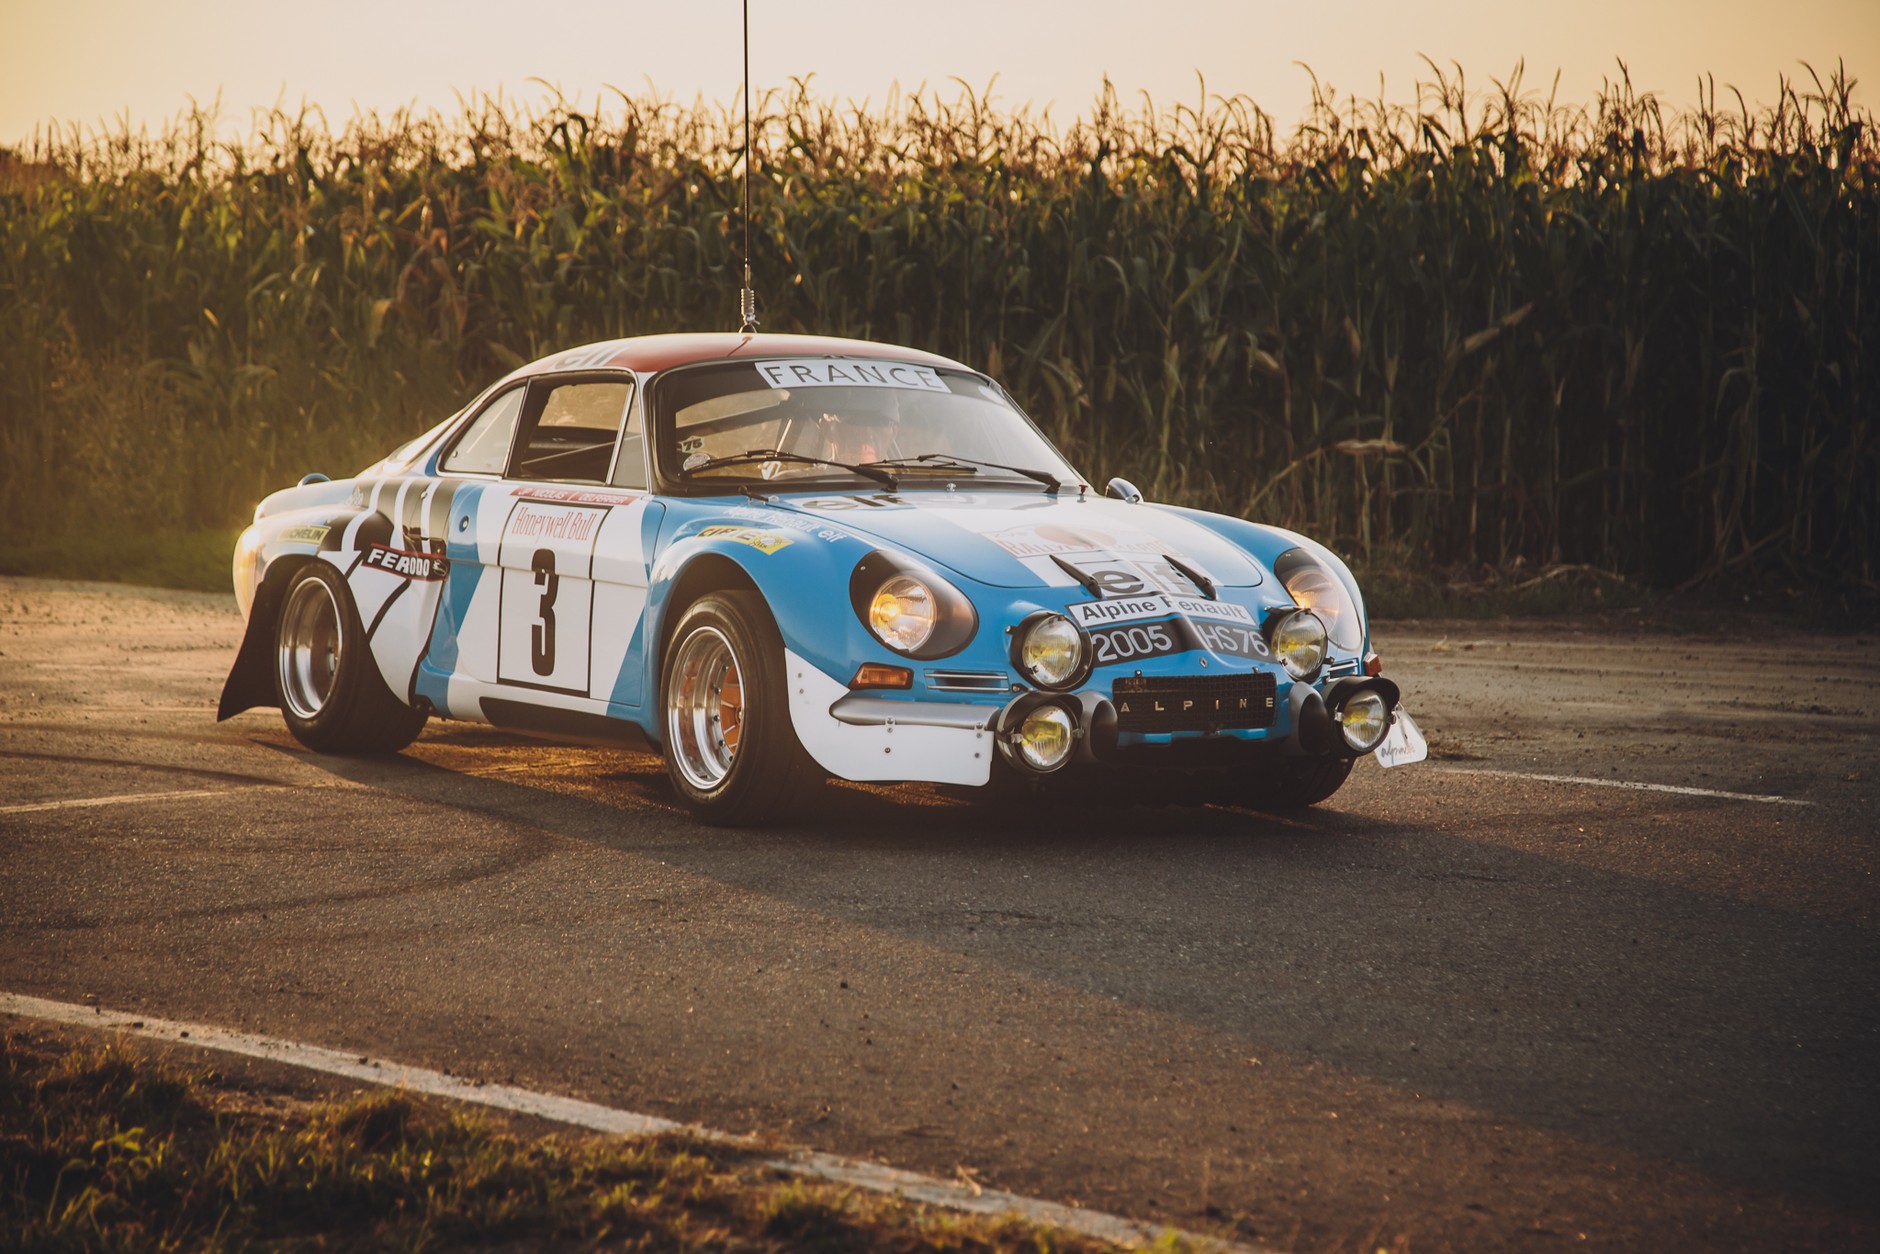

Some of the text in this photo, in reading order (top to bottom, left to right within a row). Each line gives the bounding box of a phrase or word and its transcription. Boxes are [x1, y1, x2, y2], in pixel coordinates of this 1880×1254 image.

[763, 365, 943, 389] FRANCE
[511, 507, 598, 543] Honeywell Bull
[818, 530, 847, 543] elf
[531, 548, 560, 677] 3
[1083, 596, 1247, 620] Alpine Renault
[1091, 625, 1172, 663] 2005
[1121, 697, 1274, 713] ALPINE
